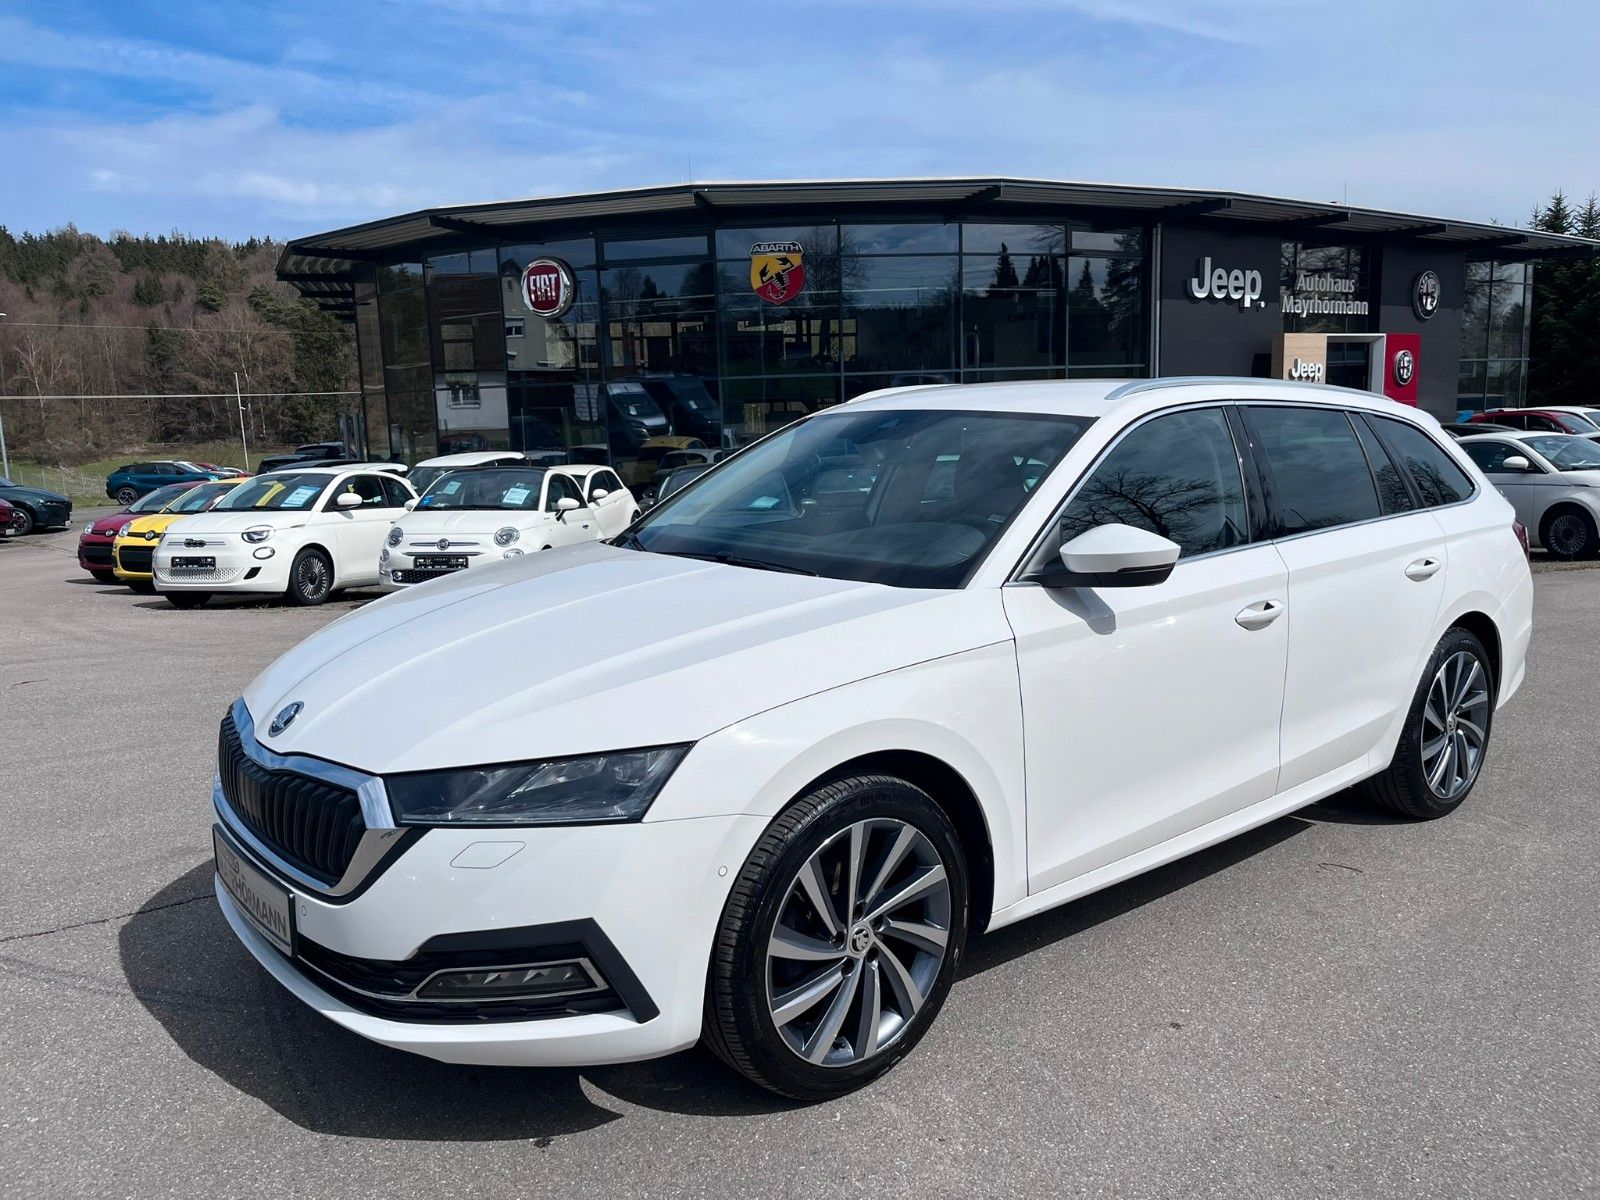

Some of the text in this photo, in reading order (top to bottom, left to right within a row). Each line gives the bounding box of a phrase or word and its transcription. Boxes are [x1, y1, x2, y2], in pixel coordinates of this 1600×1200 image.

[753, 244, 799, 252] ABARTH
[529, 273, 558, 302] FIAT
[1296, 273, 1355, 293] Autohaus
[1281, 295, 1369, 318] Mayrhörmann
[1291, 357, 1324, 381] Jeep
